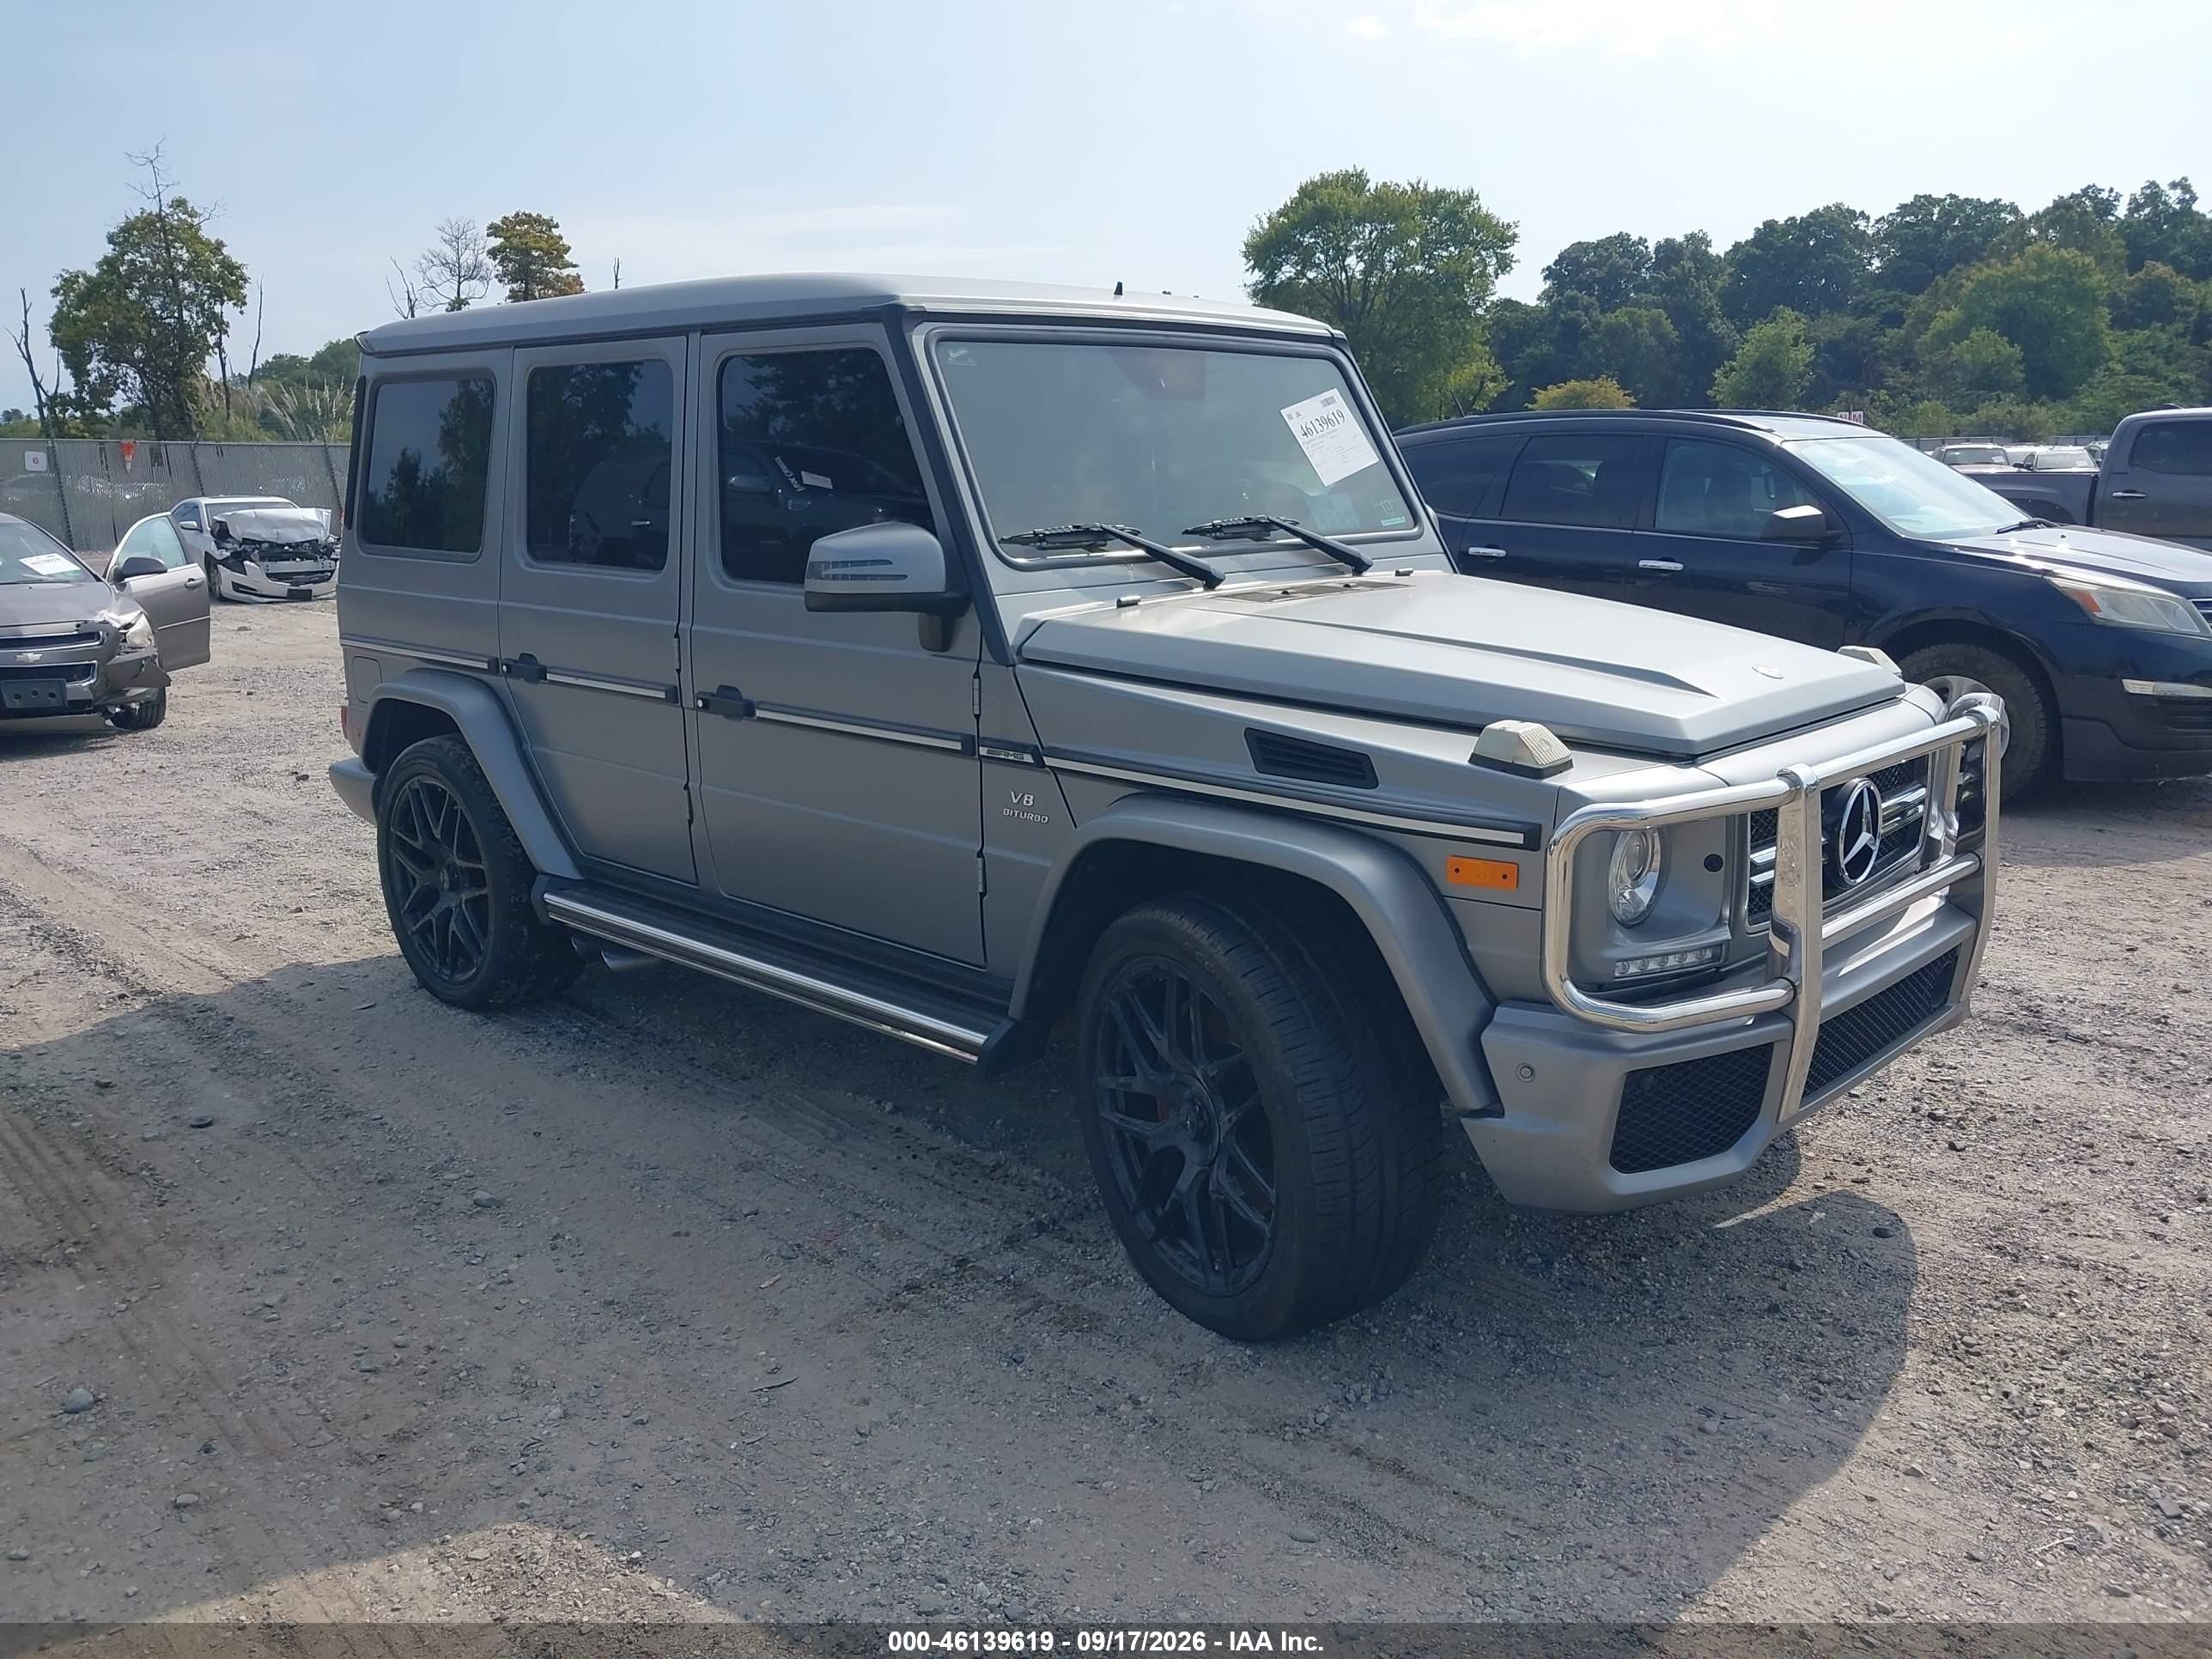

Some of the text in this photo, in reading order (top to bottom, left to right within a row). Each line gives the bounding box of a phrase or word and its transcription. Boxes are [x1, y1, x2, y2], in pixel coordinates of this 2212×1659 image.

[1300, 410, 1345, 438] 46139619
[1011, 791, 1034, 806] V8
[1003, 808, 1048, 823] BITURBO
